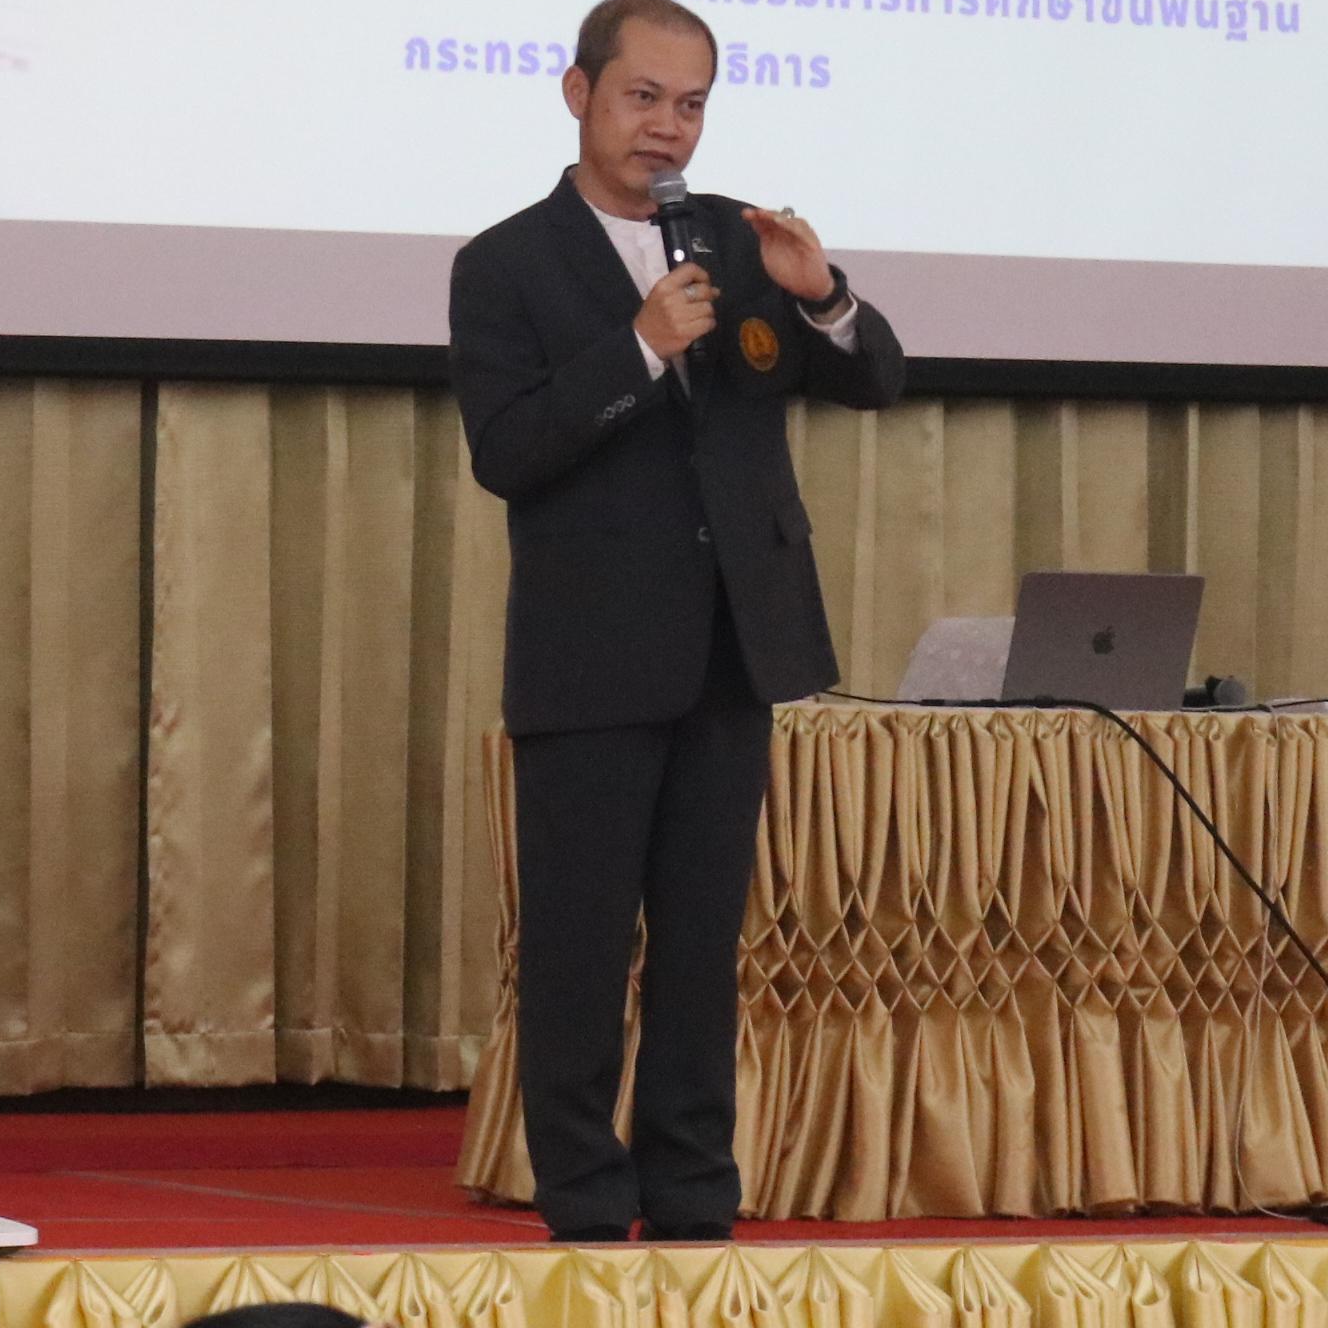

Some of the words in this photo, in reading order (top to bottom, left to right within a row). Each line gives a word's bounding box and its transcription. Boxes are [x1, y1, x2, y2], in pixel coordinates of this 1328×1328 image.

[404, 36, 832, 89] กระทรวธิการ
